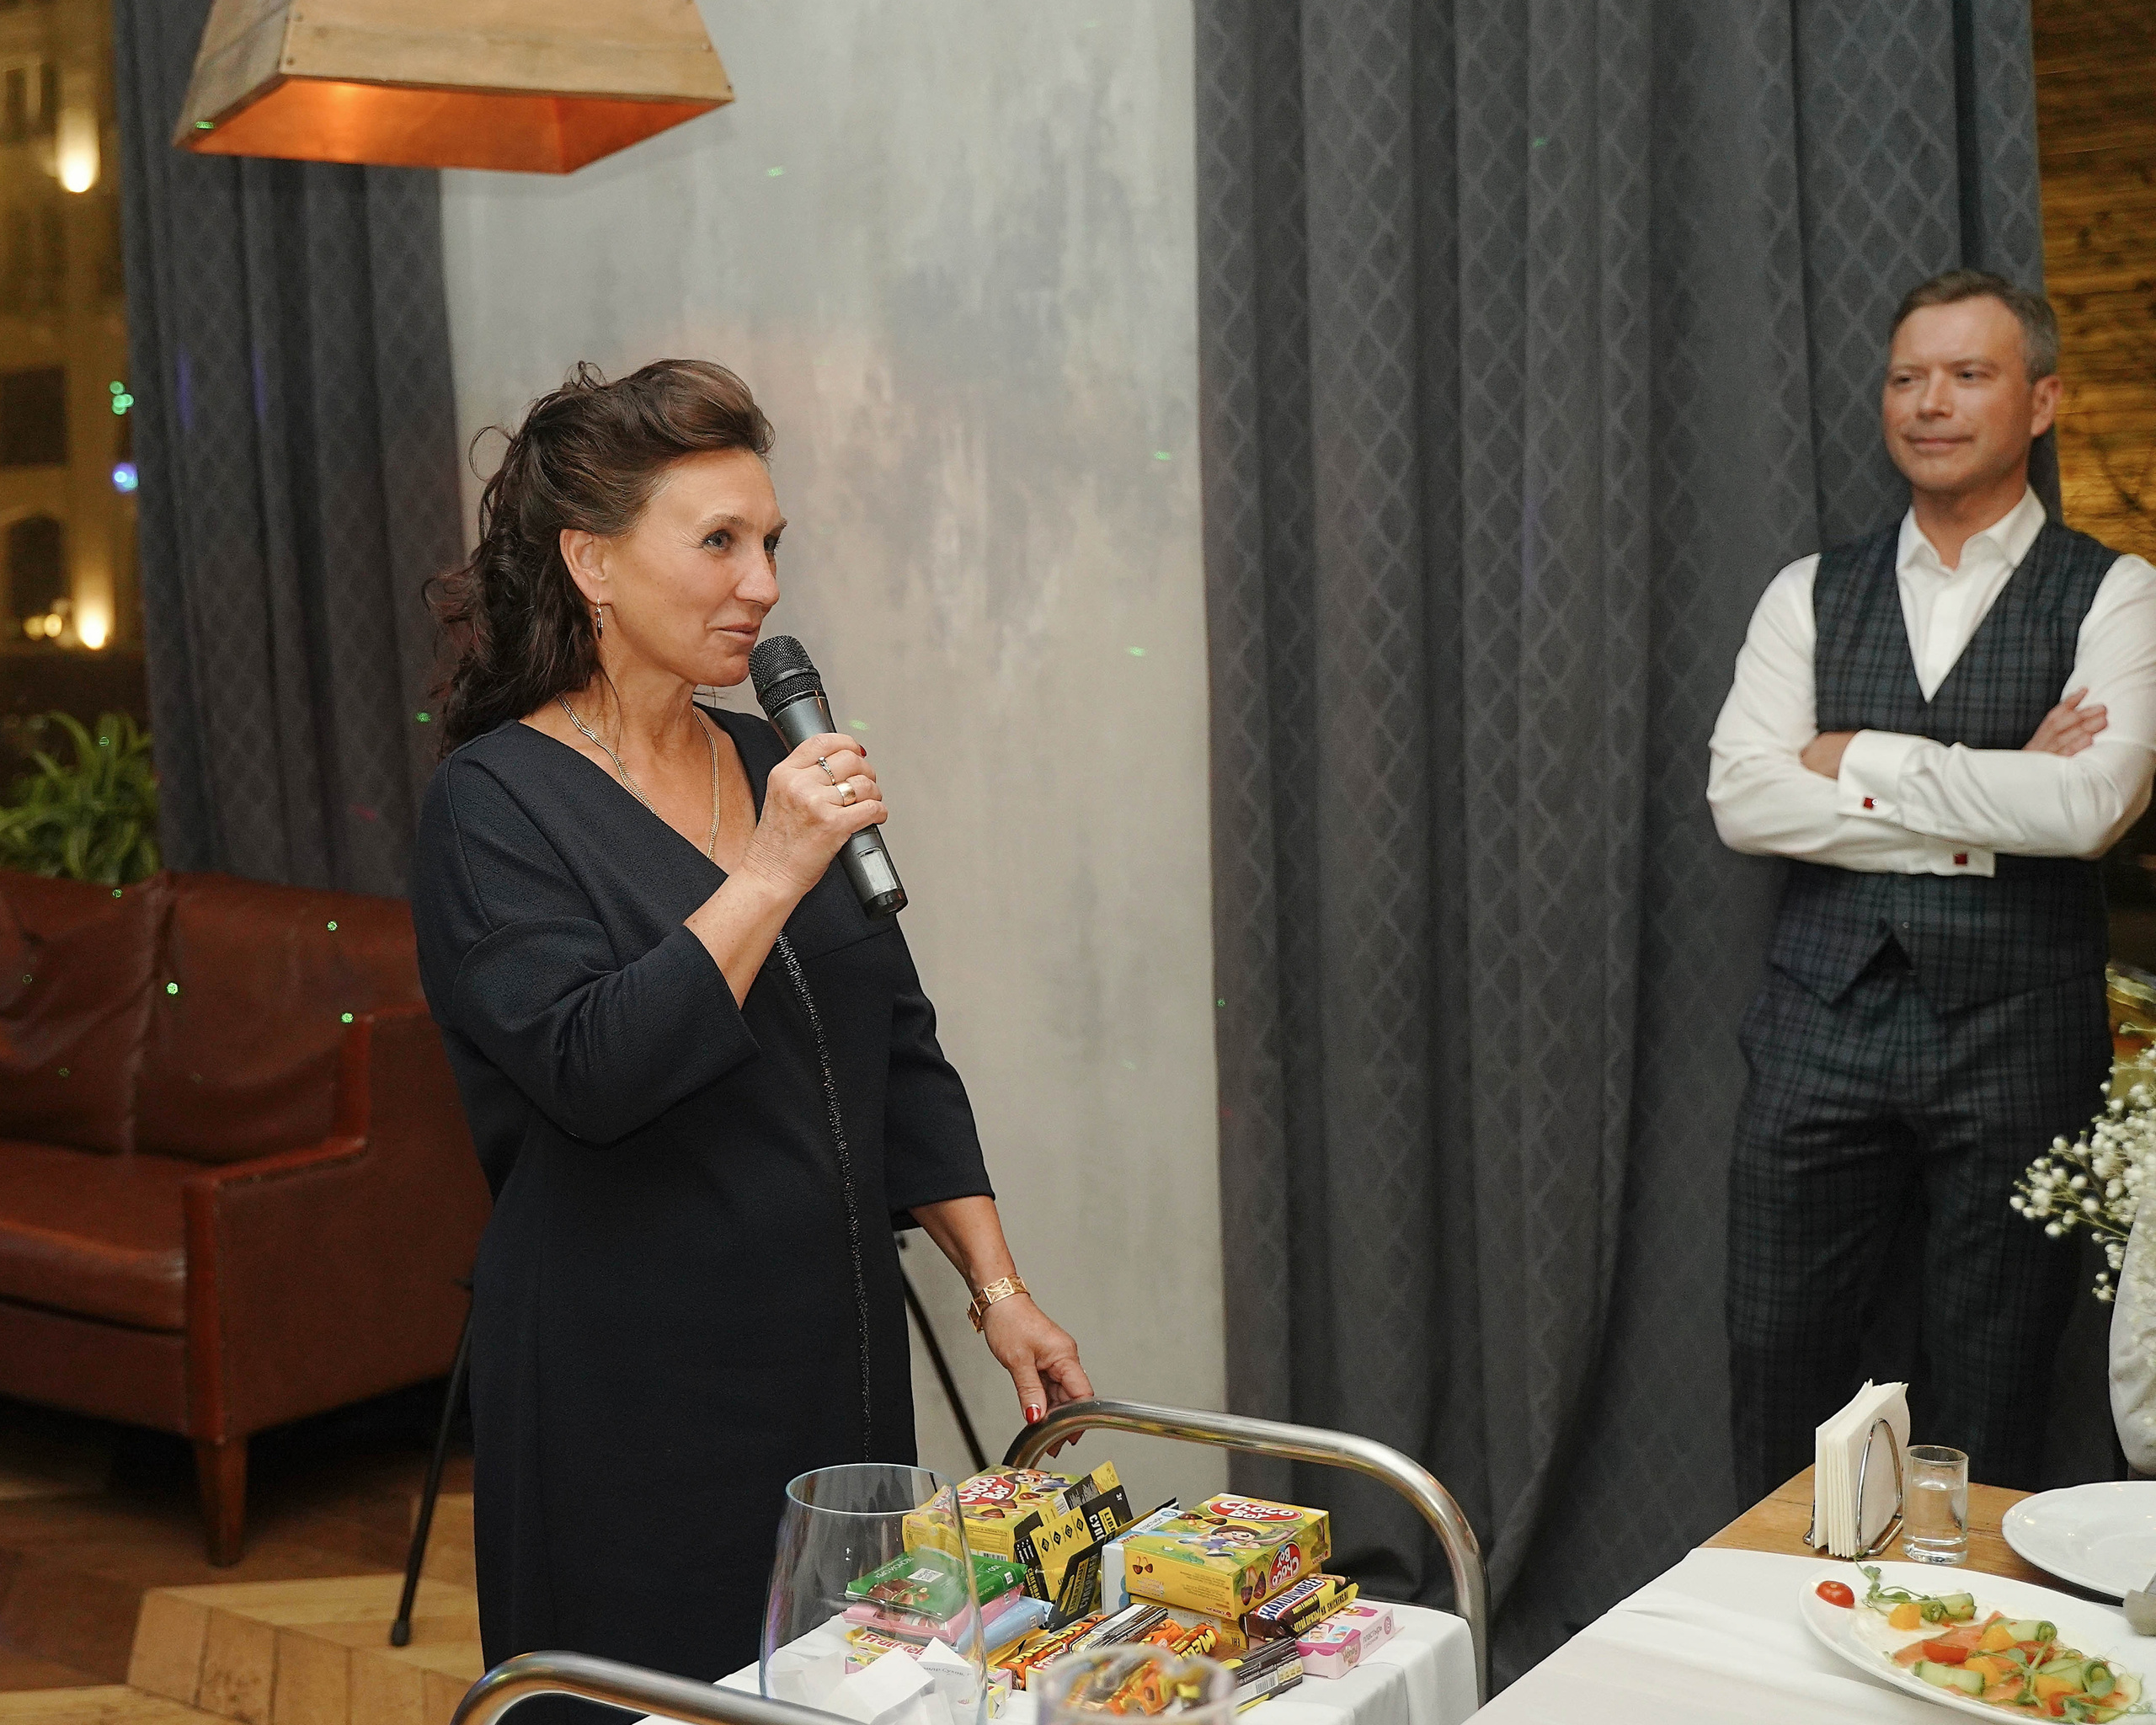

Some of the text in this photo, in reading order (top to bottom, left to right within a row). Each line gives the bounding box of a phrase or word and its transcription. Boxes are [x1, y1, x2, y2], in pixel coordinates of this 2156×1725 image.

[958, 1477, 997, 1503] Choco
[981, 1484, 1011, 1500] Boy
[1219, 1500, 1294, 1516] Choco
[1232, 1509, 1270, 1519] Boy
[1277, 1547, 1291, 1568] Boy
[1272, 1556, 1299, 1585] Choco
